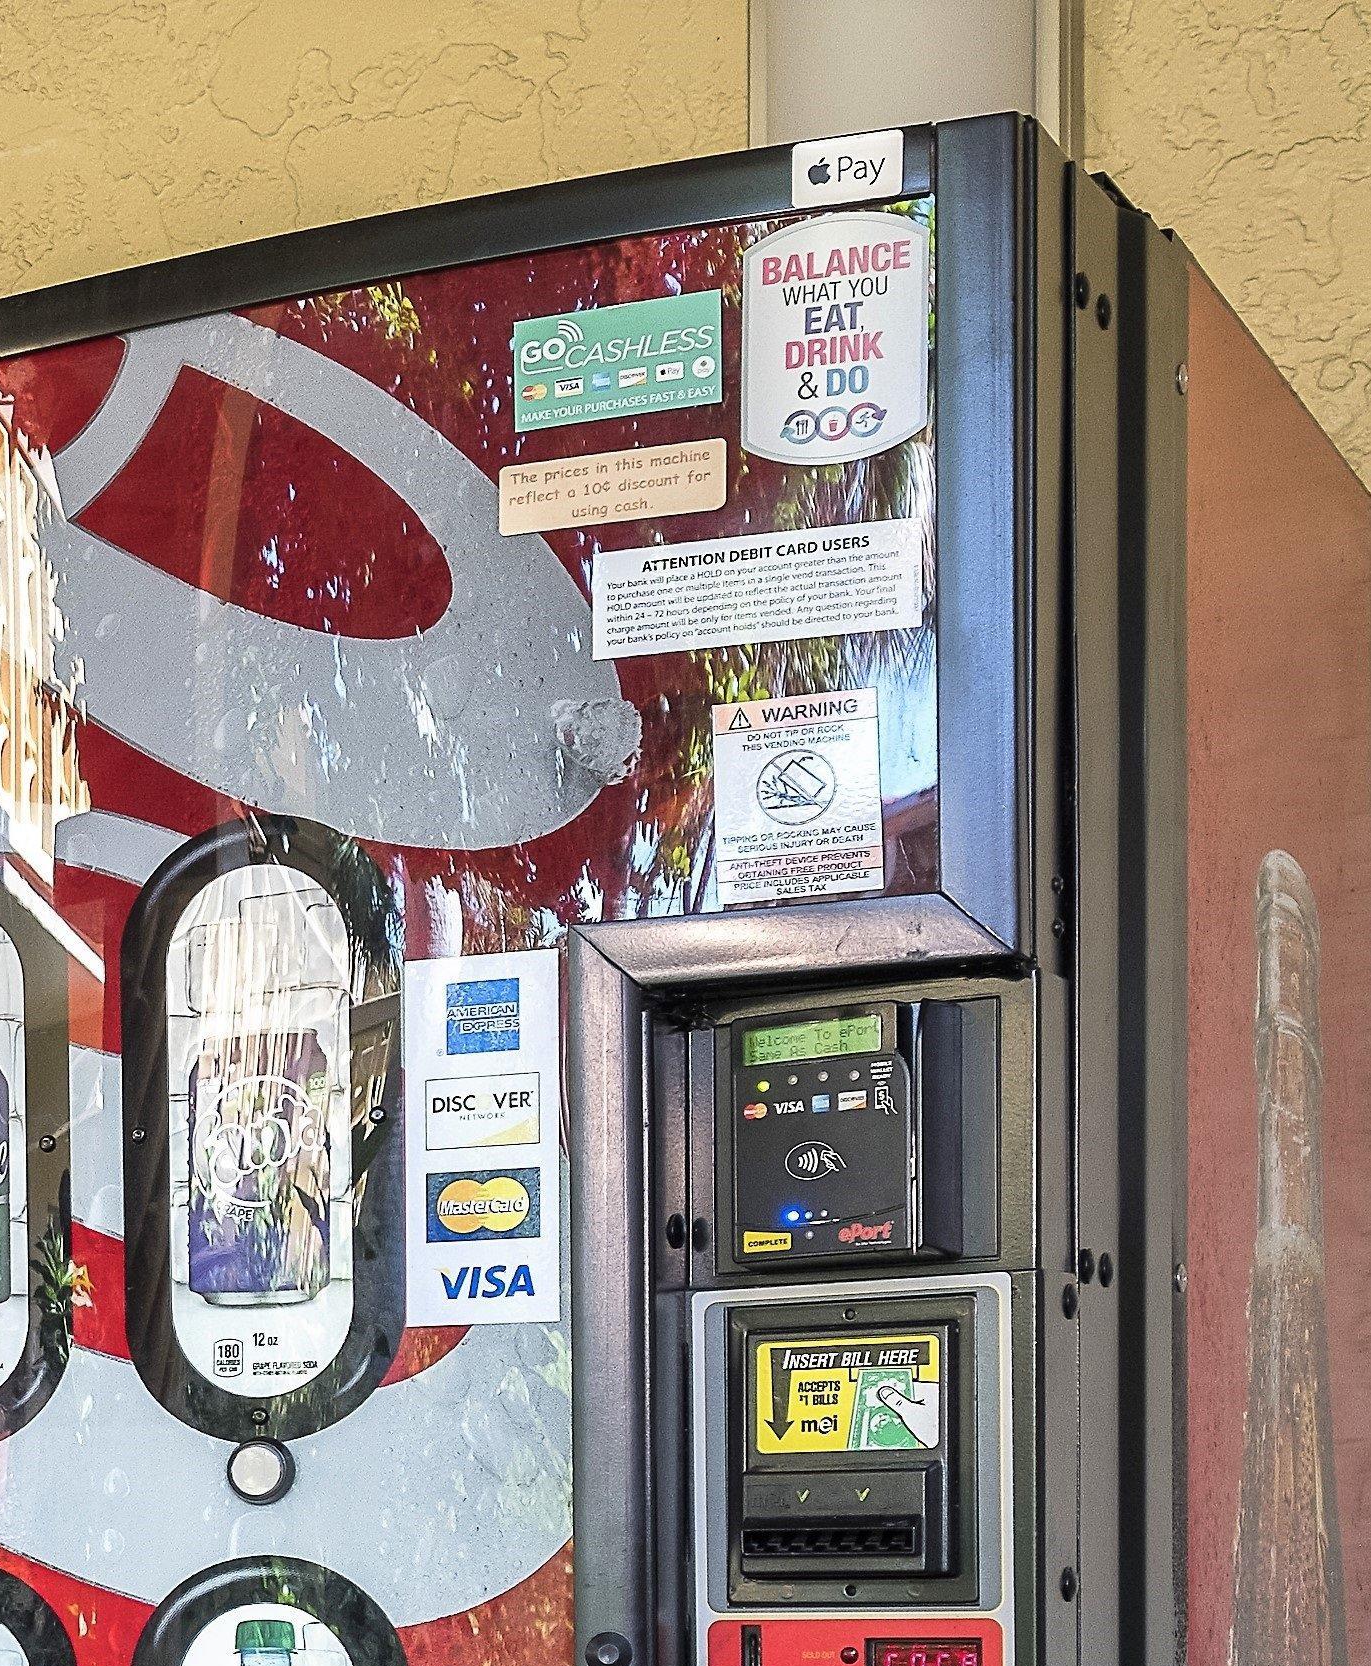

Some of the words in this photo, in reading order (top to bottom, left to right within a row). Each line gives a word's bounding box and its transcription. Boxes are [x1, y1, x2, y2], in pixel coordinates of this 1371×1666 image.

[838, 156, 885, 185] Pay
[762, 240, 910, 286] BALANCE
[782, 281, 841, 306] WHAT
[849, 276, 888, 297] YOU
[805, 301, 864, 335] EAT,
[521, 338, 566, 363] GO
[565, 326, 714, 368] CASHLESS
[785, 331, 883, 370] DRINK
[798, 372, 818, 399] &
[827, 366, 869, 396] DO
[521, 412, 551, 422] MAKE
[555, 405, 583, 417] YOUR
[585, 395, 647, 413] PURCHASES
[650, 390, 675, 404] FAST
[688, 386, 716, 398] EASY
[511, 472, 537, 484] The
[545, 467, 588, 484] prices
[596, 464, 608, 473] in
[616, 459, 643, 471] this
[650, 451, 710, 466] machine
[509, 491, 560, 506] reflect
[568, 489, 575, 498] a
[583, 481, 610, 496] 10¢
[618, 475, 679, 492] discount
[688, 470, 711, 483] for
[572, 504, 608, 518] using
[615, 498, 653, 511] cash.
[642, 552, 724, 572] ATTENTION
[730, 547, 772, 562] DEBIT
[776, 542, 818, 556] CARD
[823, 536, 869, 551] USERS
[762, 699, 857, 722] WARNING
[764, 732, 782, 740] NOT
[802, 728, 814, 736] OR
[817, 724, 844, 733] ROCK
[765, 739, 805, 749] VENDING
[809, 734, 851, 745] MACHINE
[723, 835, 758, 844] TIPPING
[761, 833, 774, 841] OR
[777, 829, 819, 840] ROCKING
[822, 826, 842, 835] MAY
[844, 823, 876, 832] CAUSE
[738, 843, 778, 853] SERIOUS
[781, 840, 813, 849] INJURY
[817, 837, 830, 845] OR
[832, 834, 863, 844] DEATH
[730, 858, 783, 870] ANTI-THEFT
[786, 854, 818, 865] DEVICE
[821, 851, 870, 861] PREVENTS
[738, 868, 788, 879] OBTAINING
[791, 865, 814, 873] FREE
[817, 861, 862, 871] PRODUCT
[734, 881, 761, 890] PRICE
[764, 877, 810, 887] INCLUDES
[812, 871, 869, 882] APPLICABLE
[776, 886, 806, 895] SALES
[809, 884, 826, 892] TAX
[447, 1004, 515, 1019] AMERICAN
[461, 1018, 520, 1031] EXPRESS
[749, 1033, 806, 1049] Welcome
[815, 1029, 831, 1040] To
[840, 1019, 879, 1038] ePort
[750, 1050, 781, 1063] Same
[791, 1046, 806, 1056] As
[815, 1041, 847, 1054] Cash
[459, 1112, 505, 1121] NETWORK
[439, 1196, 524, 1216] MasterCard
[839, 1220, 894, 1243] ePort
[748, 1238, 787, 1247] COMPLETE
[438, 1265, 535, 1300] VISA
[218, 1344, 239, 1358] 180
[253, 1333, 264, 1346] 12
[268, 1337, 278, 1345] oz
[783, 1350, 839, 1370] INSERT
[841, 1351, 872, 1366] BILL
[878, 1349, 919, 1365] HERE
[798, 1381, 840, 1392] ACCEPTS
[801, 1415, 838, 1434] mei
